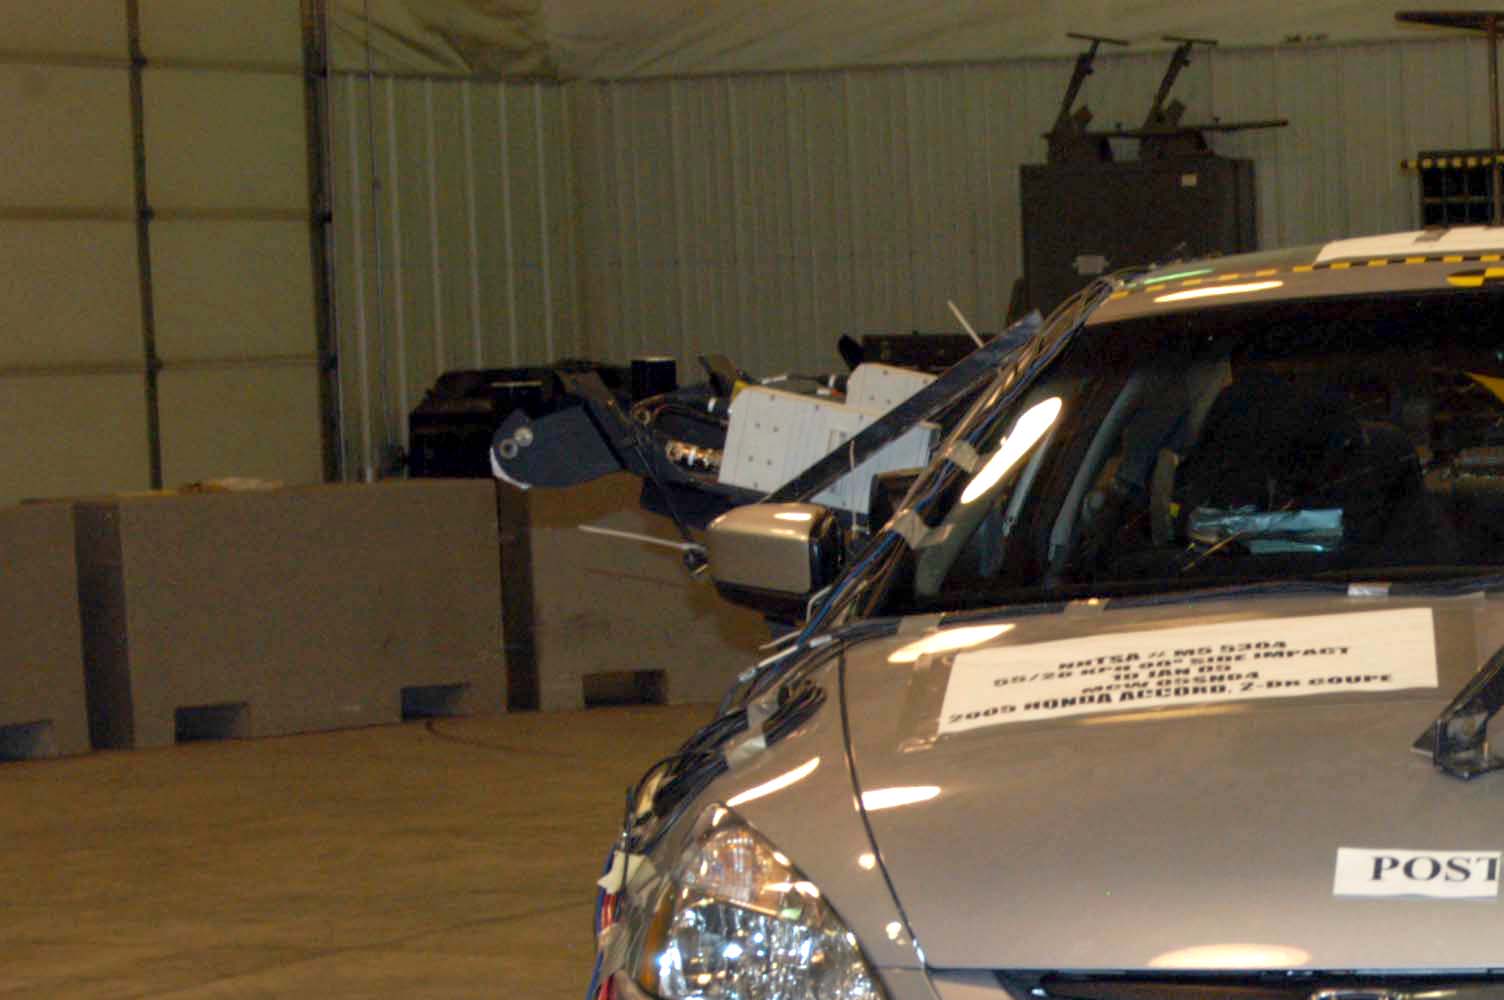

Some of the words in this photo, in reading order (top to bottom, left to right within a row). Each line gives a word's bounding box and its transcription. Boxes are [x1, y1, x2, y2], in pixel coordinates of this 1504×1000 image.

[1058, 652, 1139, 669] NHTSA
[1190, 654, 1246, 665] SIDE
[1254, 647, 1349, 659] IMPACT
[1149, 667, 1190, 678] JAN
[949, 703, 1018, 723] 2005
[1023, 693, 1112, 710] HONDA
[1119, 685, 1232, 702] ACCORD,
[1308, 674, 1392, 686] COUPE
